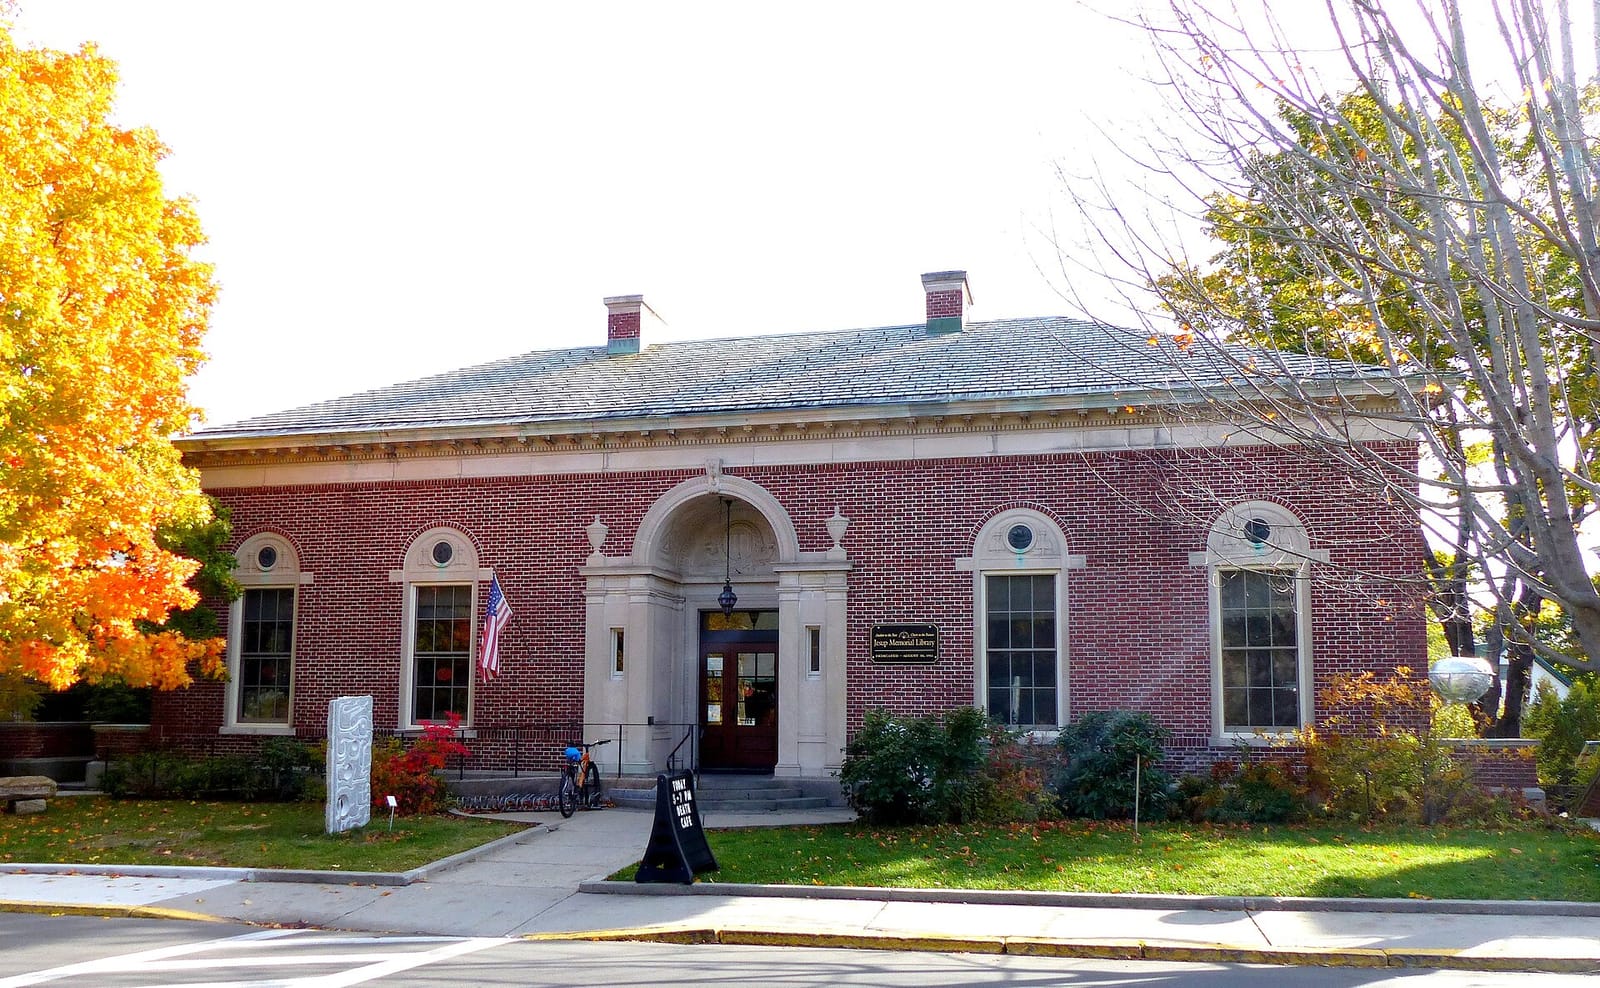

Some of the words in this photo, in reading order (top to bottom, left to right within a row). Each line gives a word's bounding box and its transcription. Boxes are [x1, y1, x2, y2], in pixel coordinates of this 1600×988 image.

[874, 639, 888, 648] Jesup
[916, 639, 935, 647] Library
[676, 803, 692, 816] DEATH
[680, 816, 693, 829] CAFE
